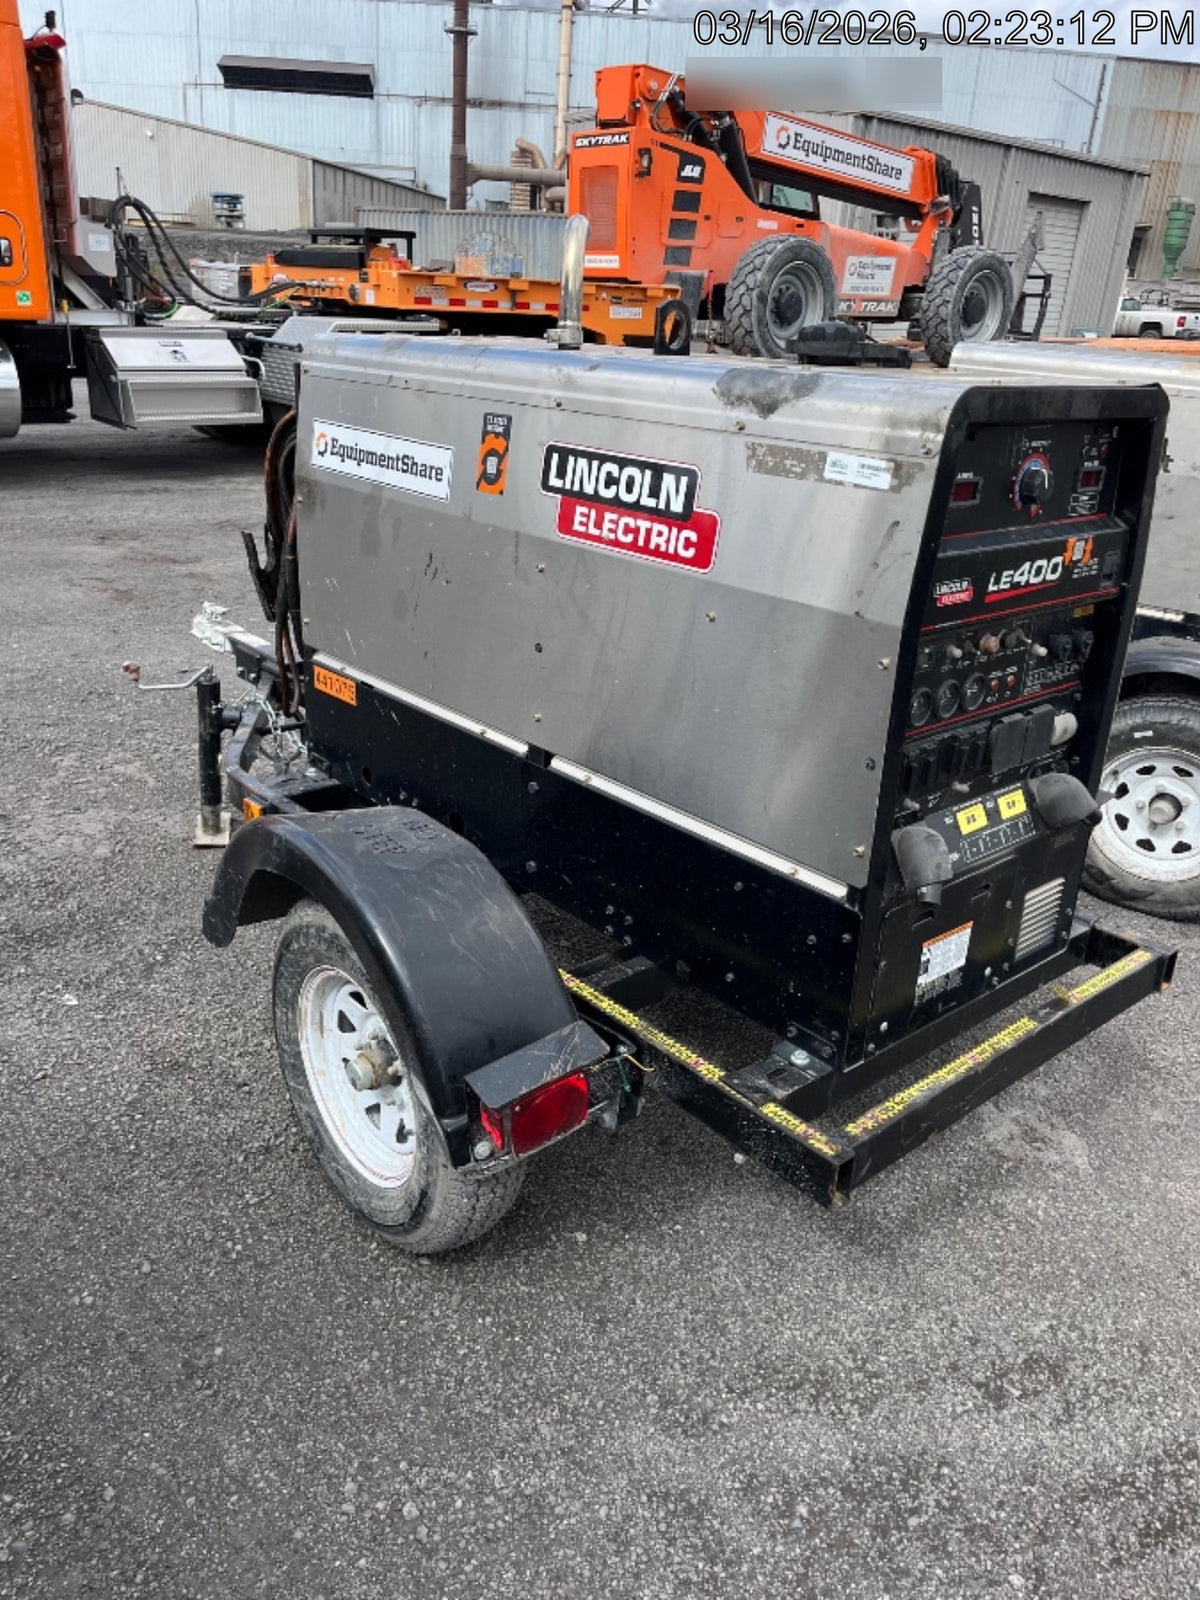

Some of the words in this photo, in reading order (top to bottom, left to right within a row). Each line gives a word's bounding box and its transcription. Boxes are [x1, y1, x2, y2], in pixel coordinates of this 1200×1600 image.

[575, 133, 629, 147] SKYTRAK
[792, 131, 903, 180] EquipmentShare
[680, 164, 702, 178] JLG
[838, 301, 897, 313] KYTRAK
[330, 437, 444, 482] EquipmentShare
[548, 452, 688, 513] LINCOLN
[572, 505, 697, 559] ELECTRIC
[935, 580, 969, 595] LINCOLN
[987, 555, 1064, 593] LE400
